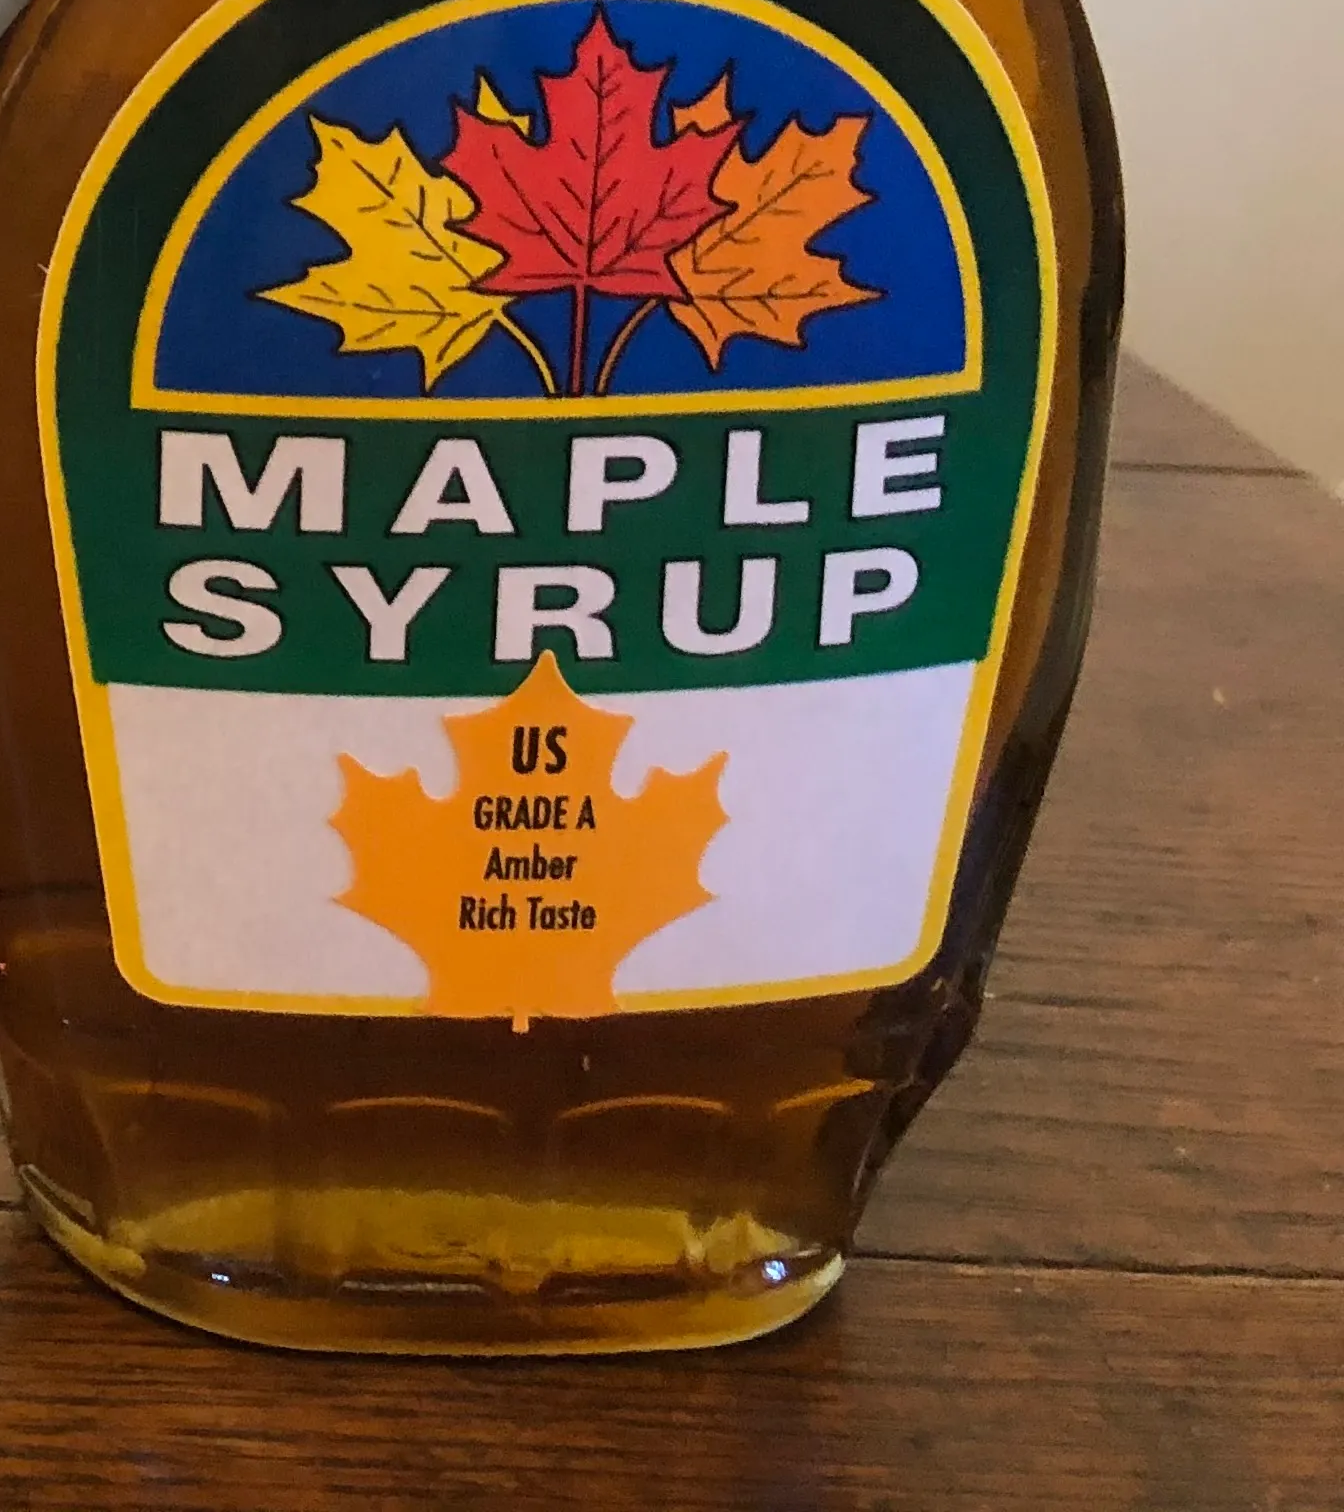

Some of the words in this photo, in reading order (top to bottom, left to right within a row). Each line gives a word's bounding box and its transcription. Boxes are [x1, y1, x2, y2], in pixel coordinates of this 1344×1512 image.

[155, 414, 949, 537] MAPLE
[160, 545, 921, 667] SYRUP
[512, 726, 568, 775] US
[474, 797, 568, 832] GRADE
[576, 796, 596, 830] A
[484, 848, 577, 883] Amber
[459, 896, 518, 932] Rich
[527, 897, 597, 930] Taste
